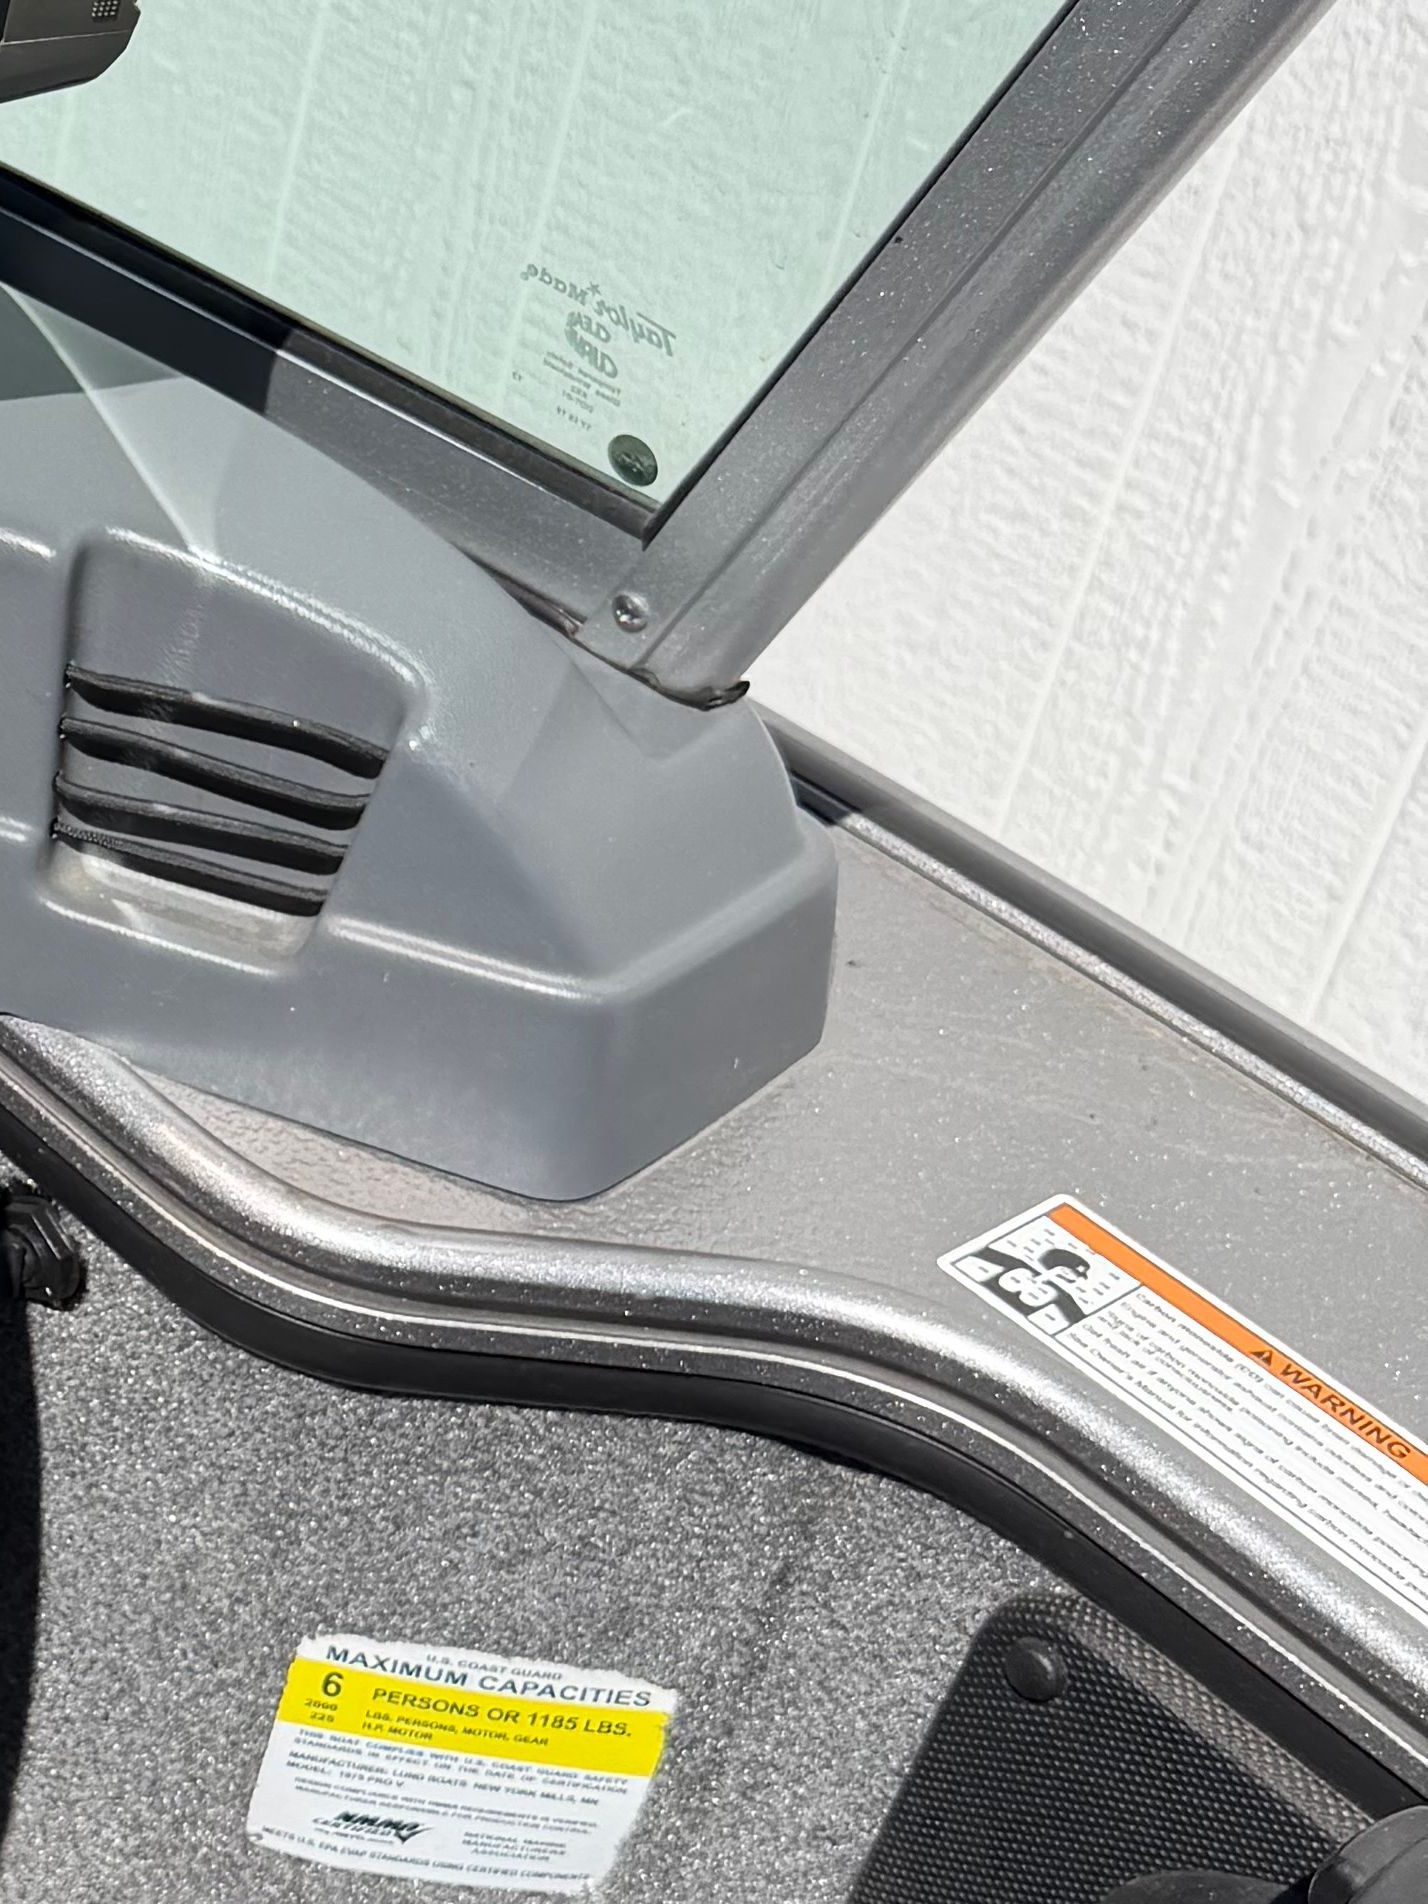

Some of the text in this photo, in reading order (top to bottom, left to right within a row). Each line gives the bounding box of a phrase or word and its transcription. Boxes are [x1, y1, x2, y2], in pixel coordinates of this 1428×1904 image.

[1280, 1363, 1411, 1459] WARNING
[326, 1645, 652, 1707] MAXIMUM CAPACITIES
[457, 1659, 507, 1678] COAST
[511, 1665, 563, 1680] GUARD
[321, 1672, 632, 1737] 6 PERSONS OR 1185 LBS.
[514, 1734, 548, 1748] GEAR
